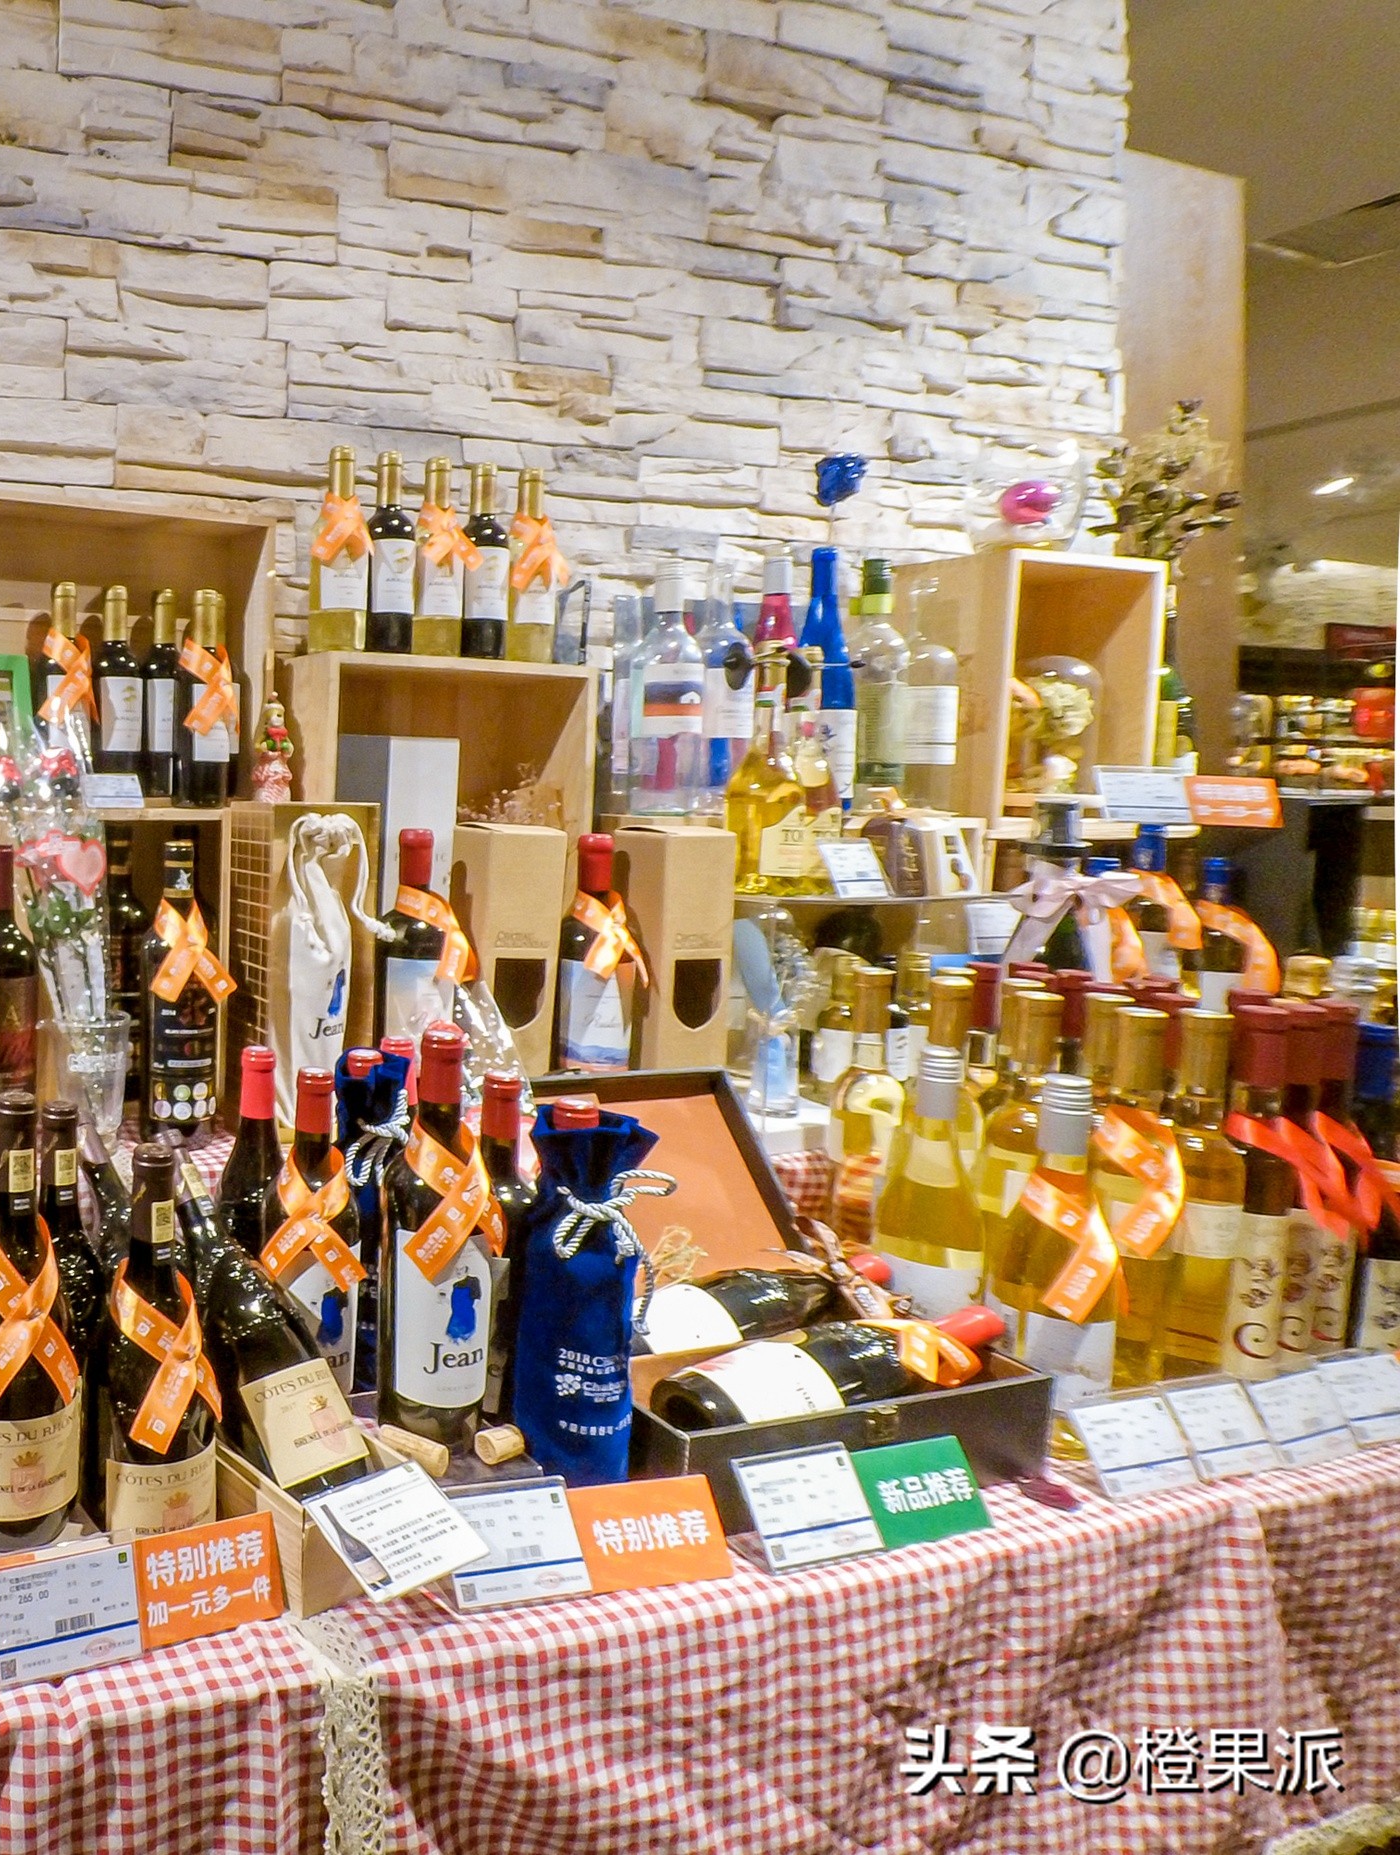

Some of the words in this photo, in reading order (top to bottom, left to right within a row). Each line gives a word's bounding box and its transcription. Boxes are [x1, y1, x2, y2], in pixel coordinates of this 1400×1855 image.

[326, 1349, 352, 1367] an
[423, 1341, 485, 1375] Jean
[558, 1347, 591, 1364] 2018
[254, 1381, 295, 1404] CÔTES
[16, 1428, 38, 1443] DU
[42, 1413, 78, 1441] RHÔN
[115, 1468, 161, 1487] CÔTES
[164, 1469, 187, 1483] DU
[878, 1466, 975, 1515] 新品推荐
[592, 1508, 711, 1557] 特别推荐
[146, 1529, 266, 1591] 特别推荐
[147, 1573, 271, 1629] 加一元多一件
